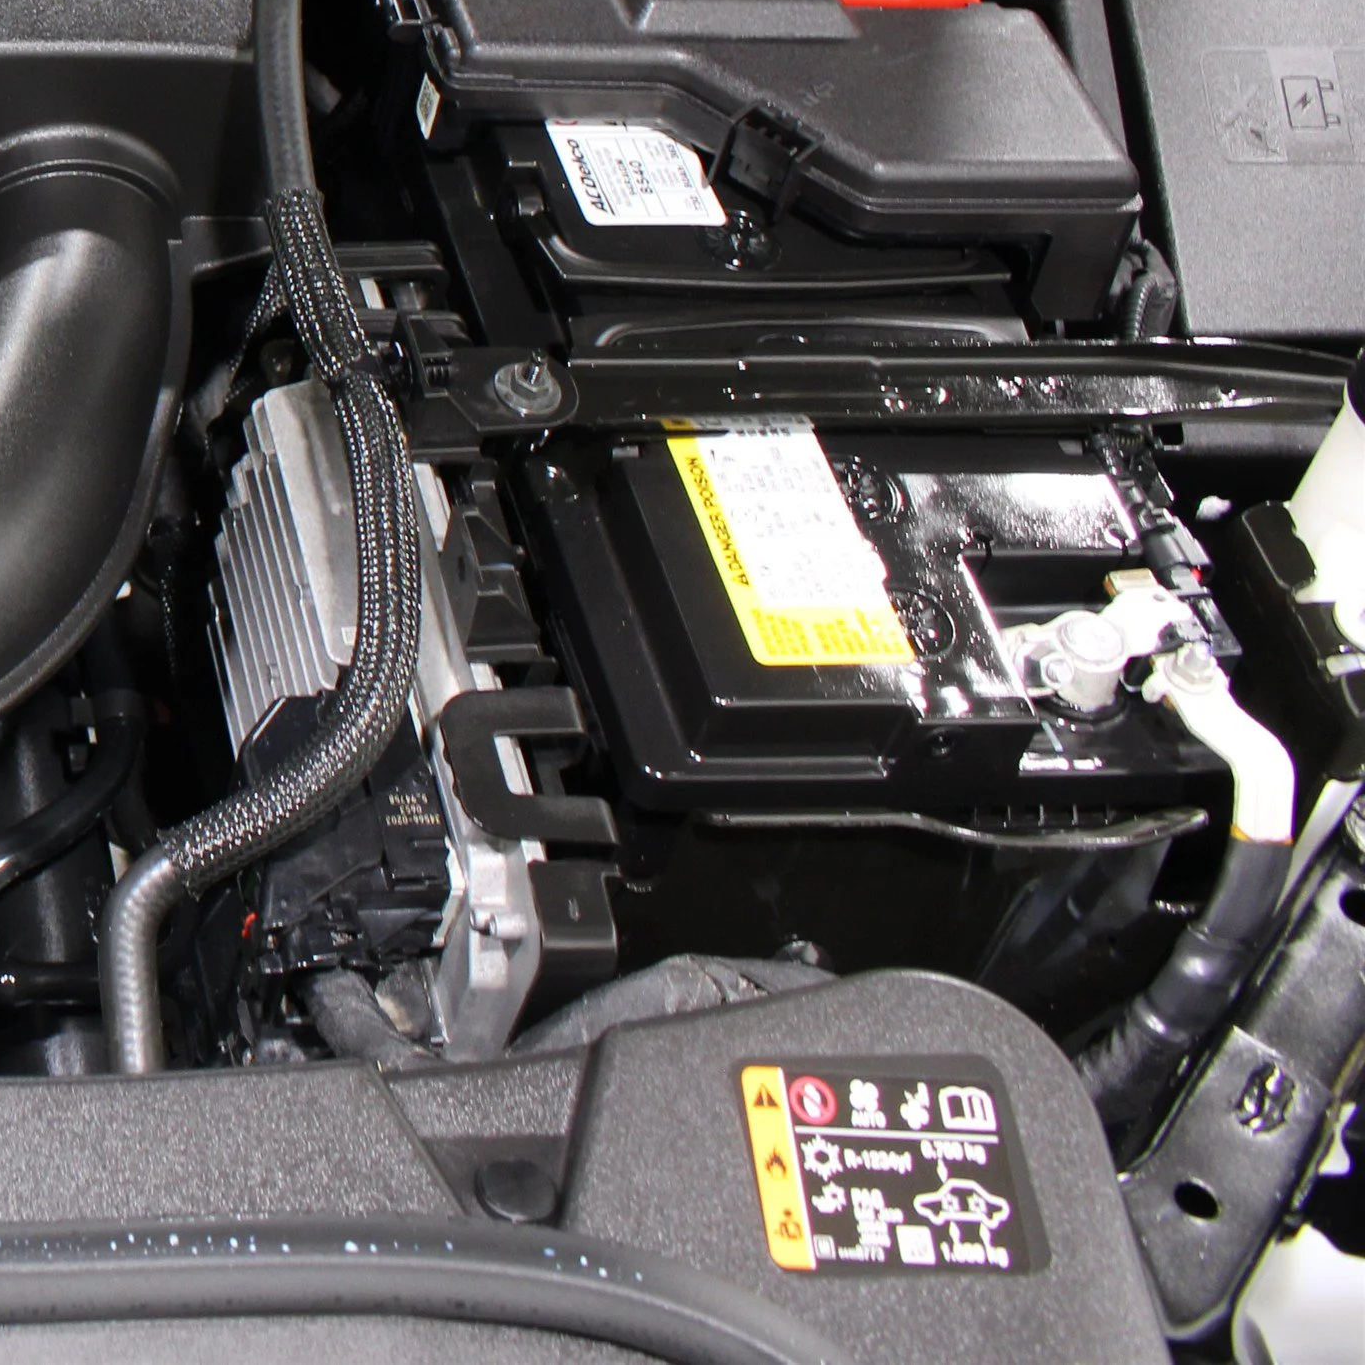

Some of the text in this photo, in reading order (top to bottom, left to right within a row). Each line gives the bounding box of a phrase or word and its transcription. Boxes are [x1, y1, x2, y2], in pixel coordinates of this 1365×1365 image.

[566, 138, 609, 213] ACDelco
[685, 456, 743, 572] DANGER POISON
